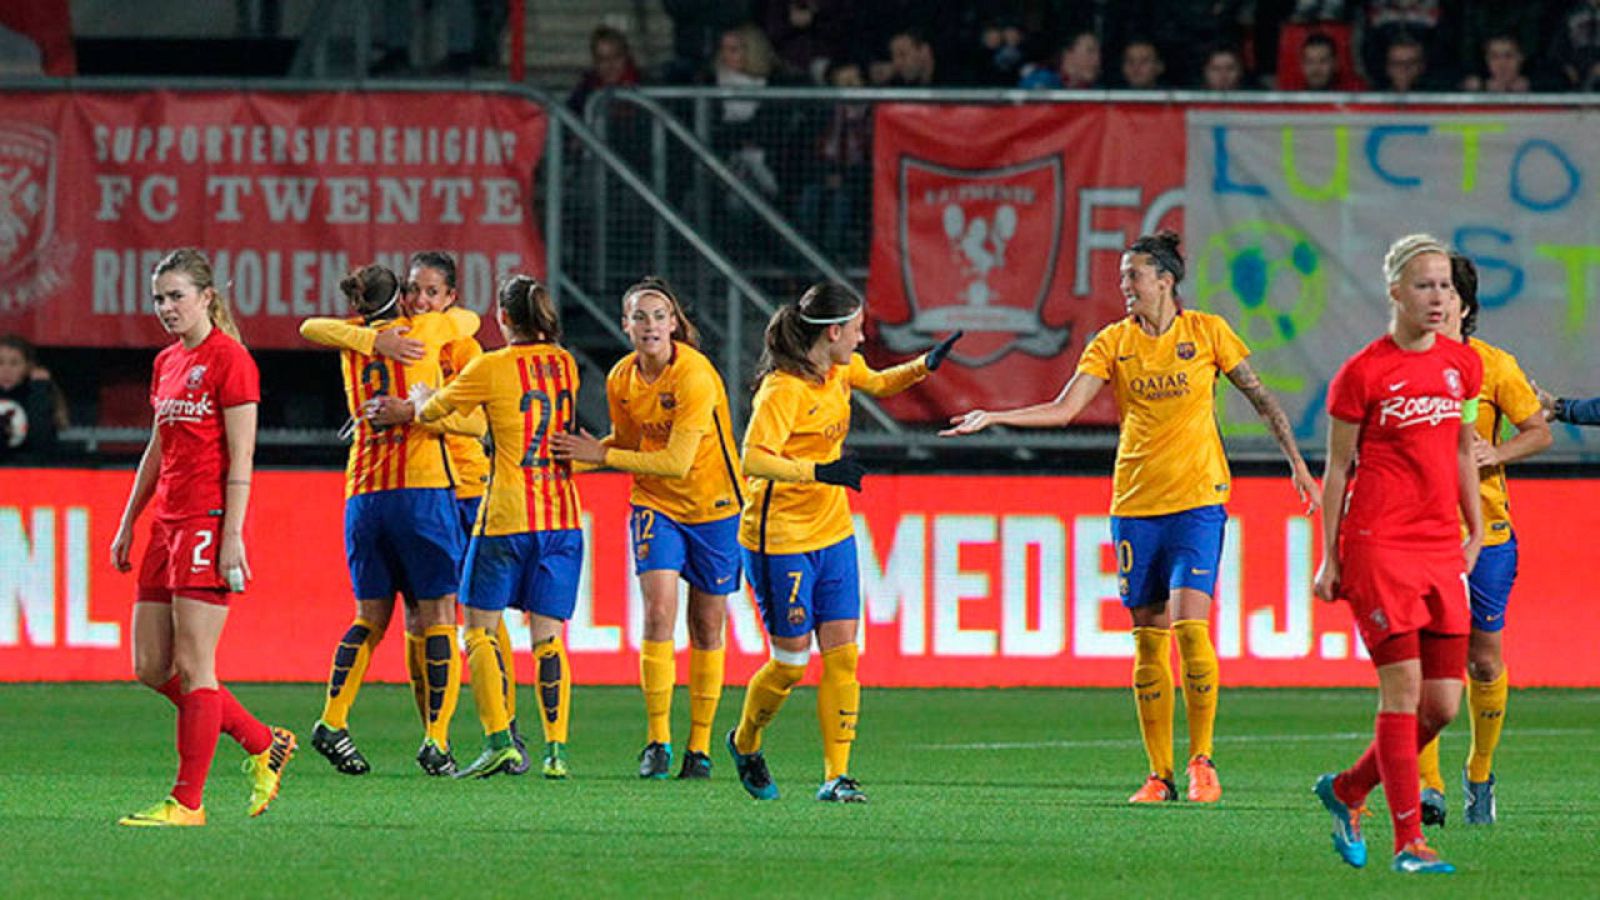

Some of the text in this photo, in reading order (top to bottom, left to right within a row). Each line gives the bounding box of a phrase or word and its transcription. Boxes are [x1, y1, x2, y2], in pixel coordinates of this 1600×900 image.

[96, 174, 524, 225] FC TWENTE
[93, 249, 349, 316] RIEMOLEN
[1130, 371, 1188, 396] QATAR
[634, 509, 656, 541] 12
[192, 529, 213, 565] 2
[0, 506, 120, 647] NL
[786, 571, 804, 604] 7
